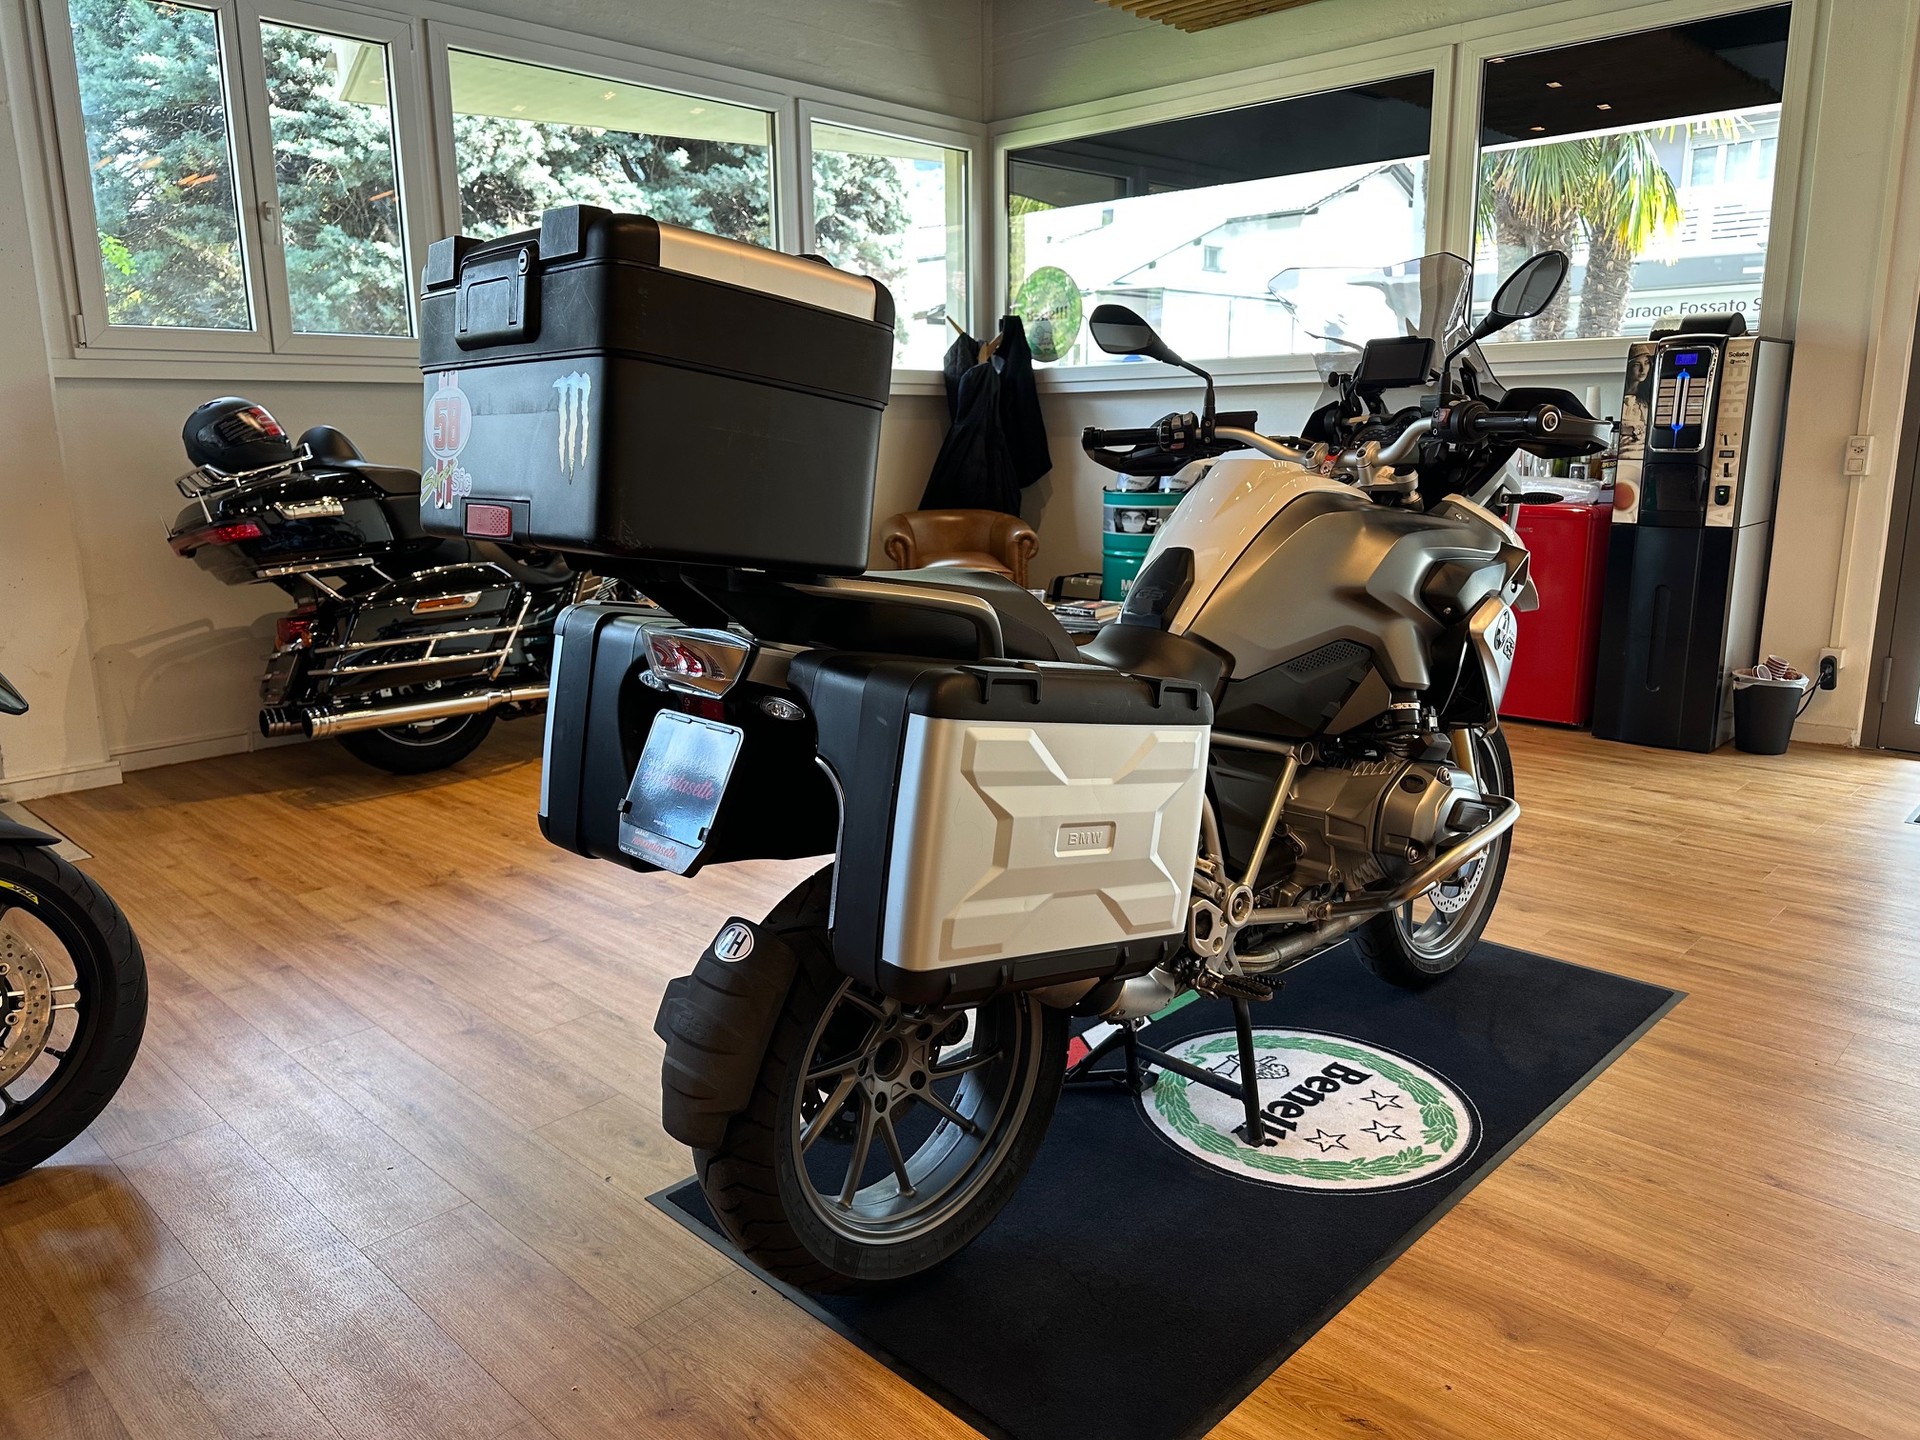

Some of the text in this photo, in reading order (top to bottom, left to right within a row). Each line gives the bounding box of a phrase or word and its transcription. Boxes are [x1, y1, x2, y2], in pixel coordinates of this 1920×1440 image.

[1624, 304, 1674, 321] arage
[1679, 299, 1747, 314] Fossato
[433, 397, 462, 450] 58
[1067, 831, 1103, 846] BMW
